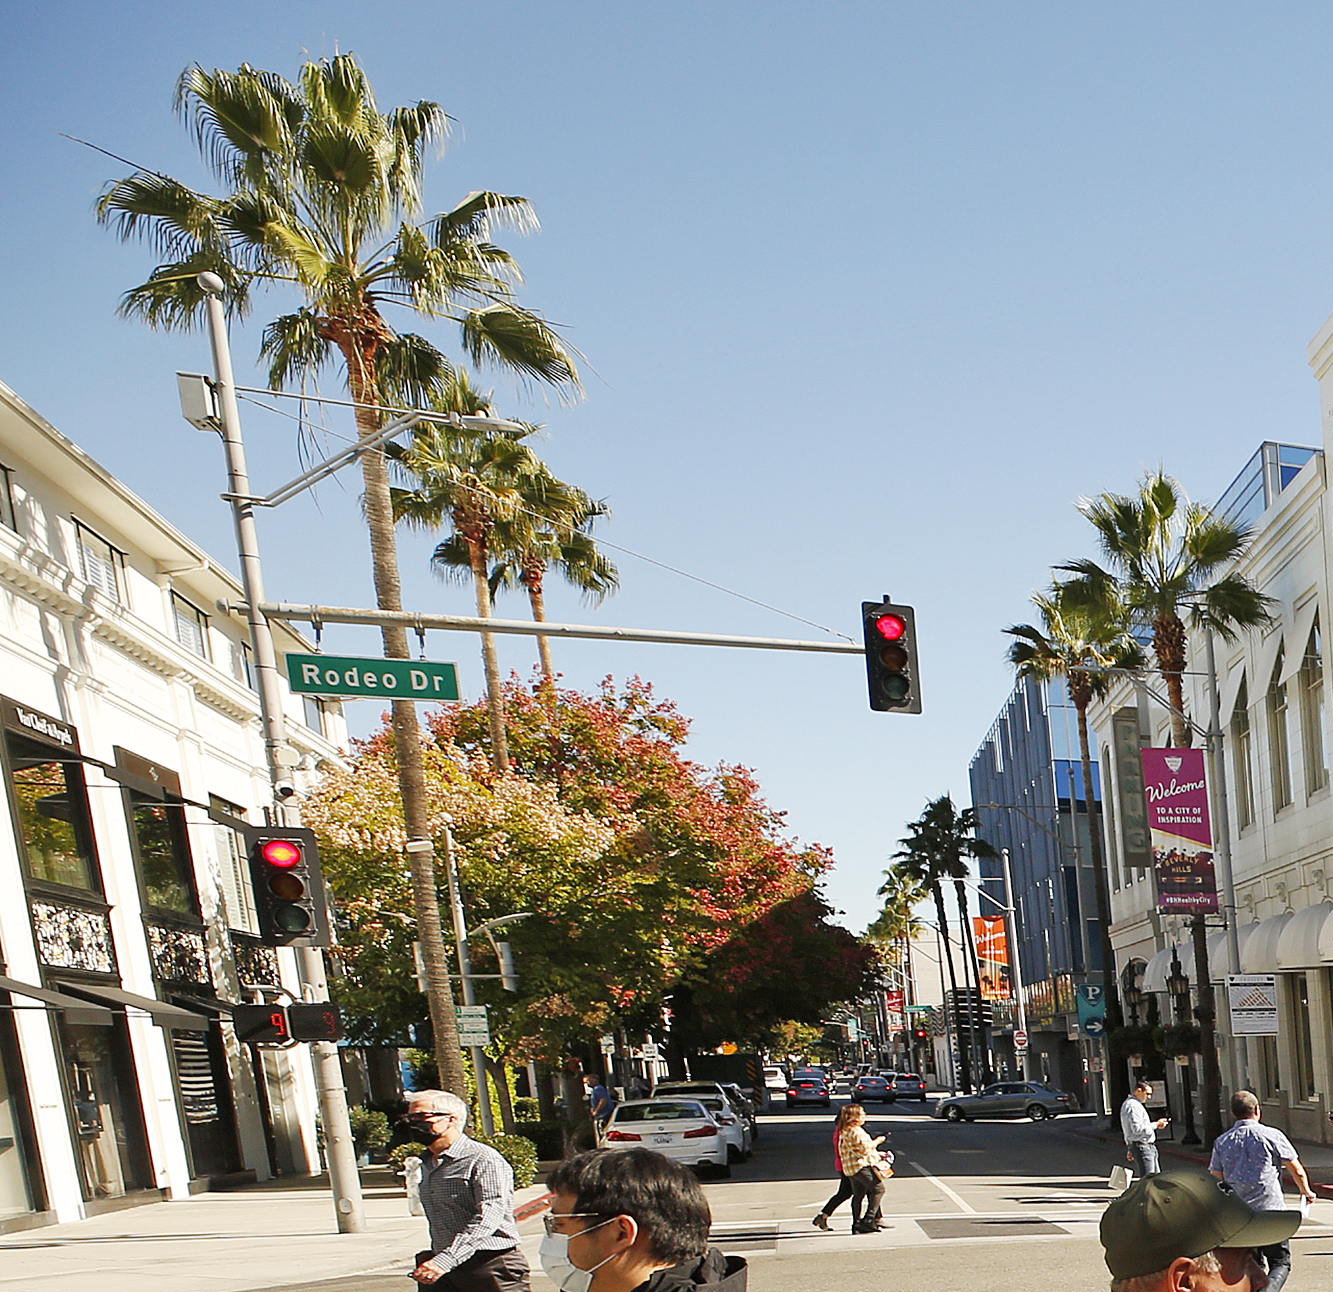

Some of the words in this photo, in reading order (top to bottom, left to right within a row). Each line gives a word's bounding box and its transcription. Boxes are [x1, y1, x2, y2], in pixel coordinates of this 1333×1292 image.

[301, 663, 397, 689] Rodeo
[409, 669, 444, 692] Dr
[1145, 778, 1205, 803] Welcome
[1175, 806, 1191, 814] CITY
[1158, 816, 1202, 824] INSPIRATION
[1164, 855, 1199, 866] BEVERLY
[1086, 986, 1100, 1000] P
[270, 1013, 286, 1036] 9
[322, 1012, 337, 1034] 9
